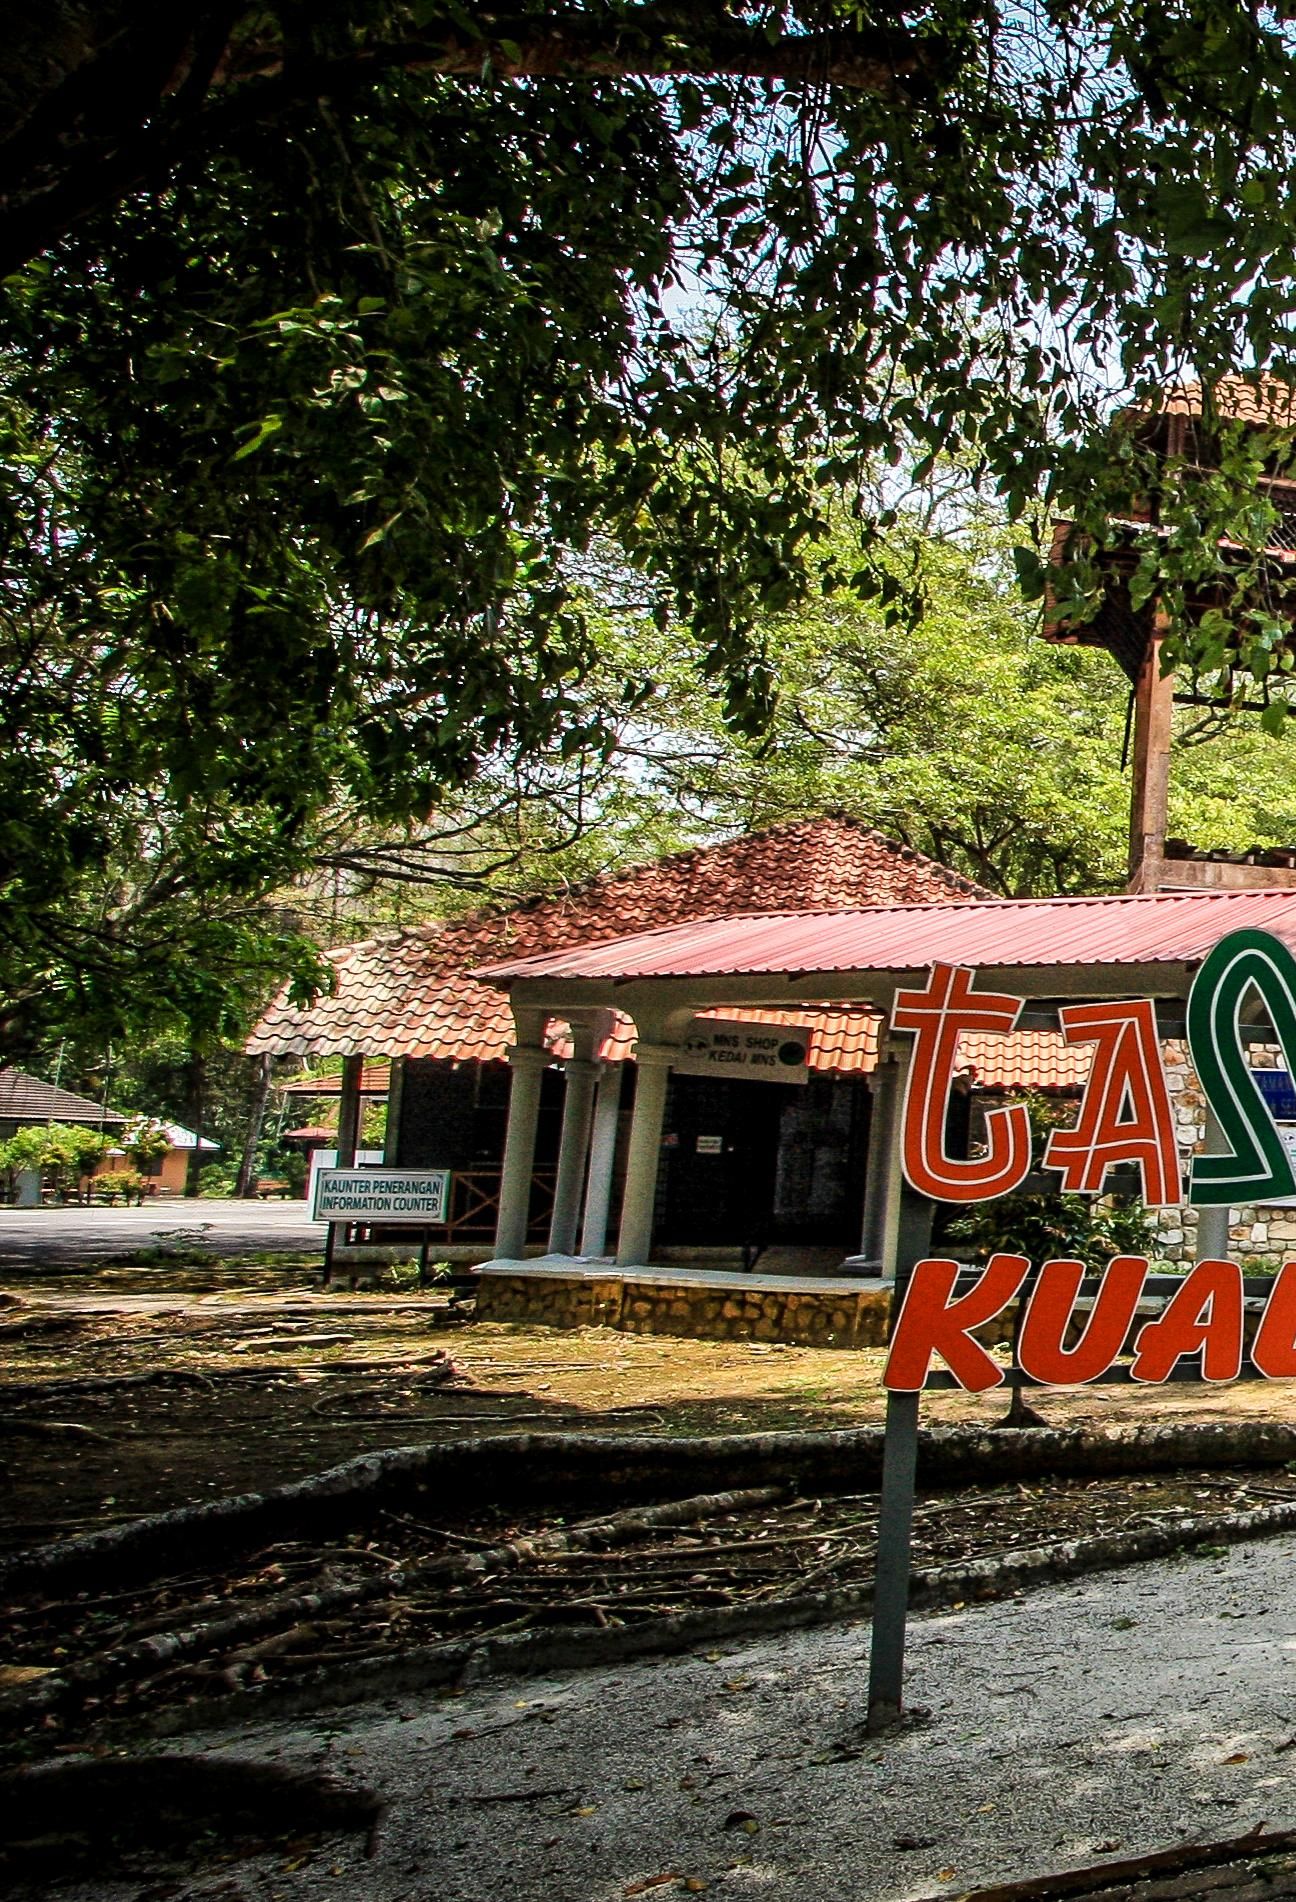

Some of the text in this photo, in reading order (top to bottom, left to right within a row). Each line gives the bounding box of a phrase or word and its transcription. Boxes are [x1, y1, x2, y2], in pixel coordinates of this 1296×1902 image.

[713, 1034, 778, 1051] MNS SHOP
[708, 1050, 777, 1066] KEDAI MNS
[323, 1180, 440, 1194] KAUNTER PENERANGAN
[322, 1197, 438, 1211] INFORMATION COUNTER
